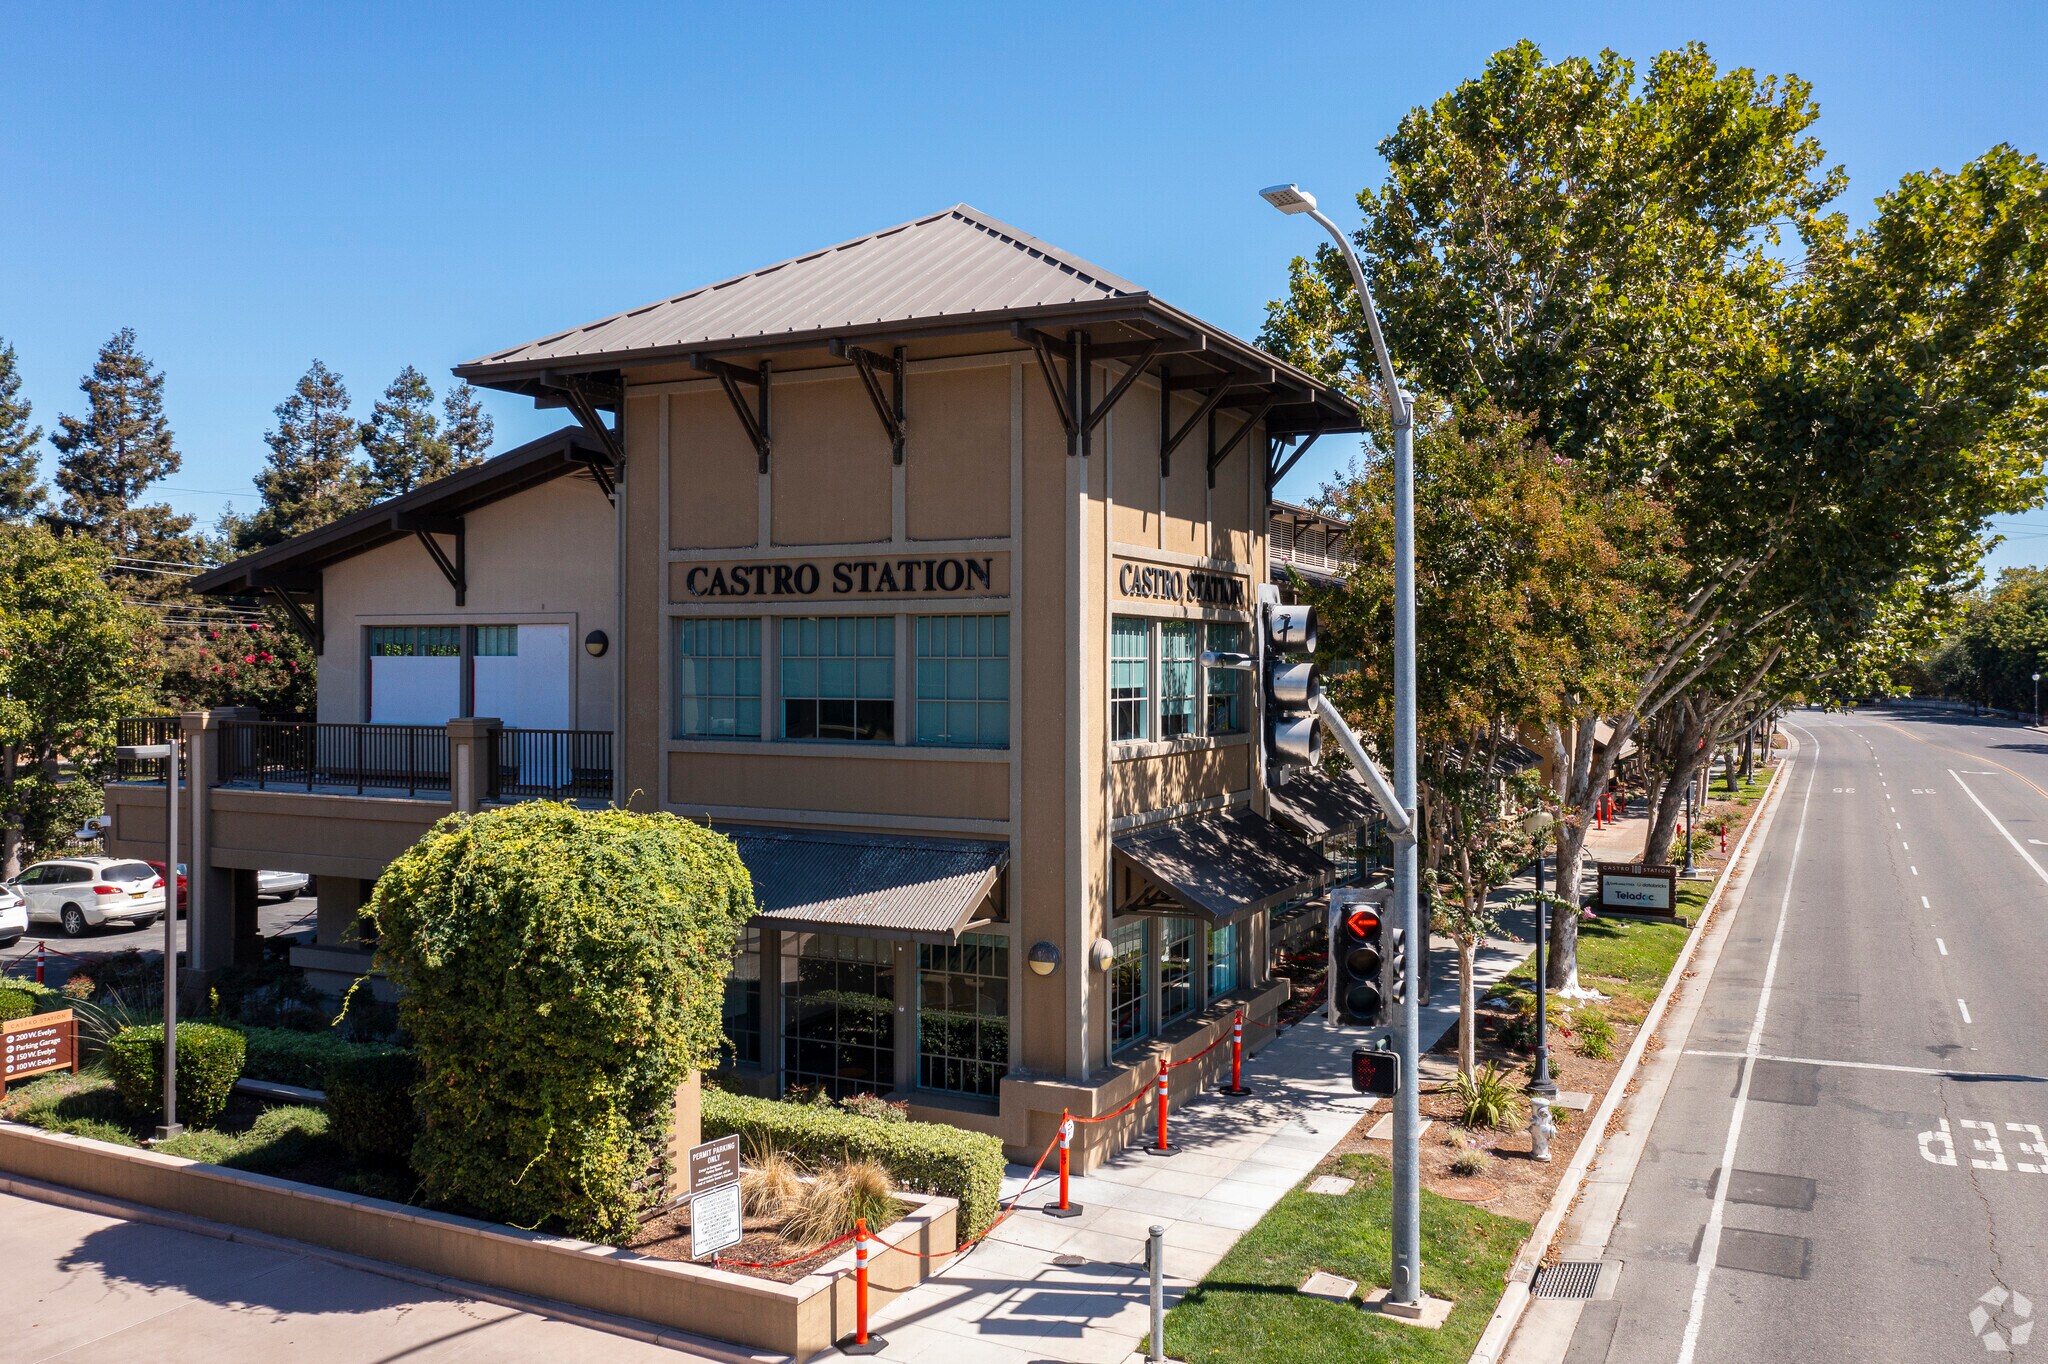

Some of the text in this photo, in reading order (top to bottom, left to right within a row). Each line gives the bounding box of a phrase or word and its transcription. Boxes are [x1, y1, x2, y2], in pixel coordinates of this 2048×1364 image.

[686, 558, 993, 597] CASTRO STATION
[1120, 562, 1246, 606] CASTRO STATION
[1631, 865, 1642, 874] 100
[1615, 890, 1655, 901] Teladoc
[10, 1014, 66, 1029] CASTRO STATION
[16, 1033, 28, 1041] 200
[37, 1028, 57, 1037] Evelyn
[16, 1037, 61, 1051] Parking Garage
[16, 1053, 28, 1061] 150
[37, 1048, 57, 1056] Evelyn
[16, 1062, 28, 1070] 100
[37, 1057, 57, 1066] Evelyn
[692, 1142, 736, 1161] PERMIT PARKING
[707, 1153, 721, 1165] ONLY
